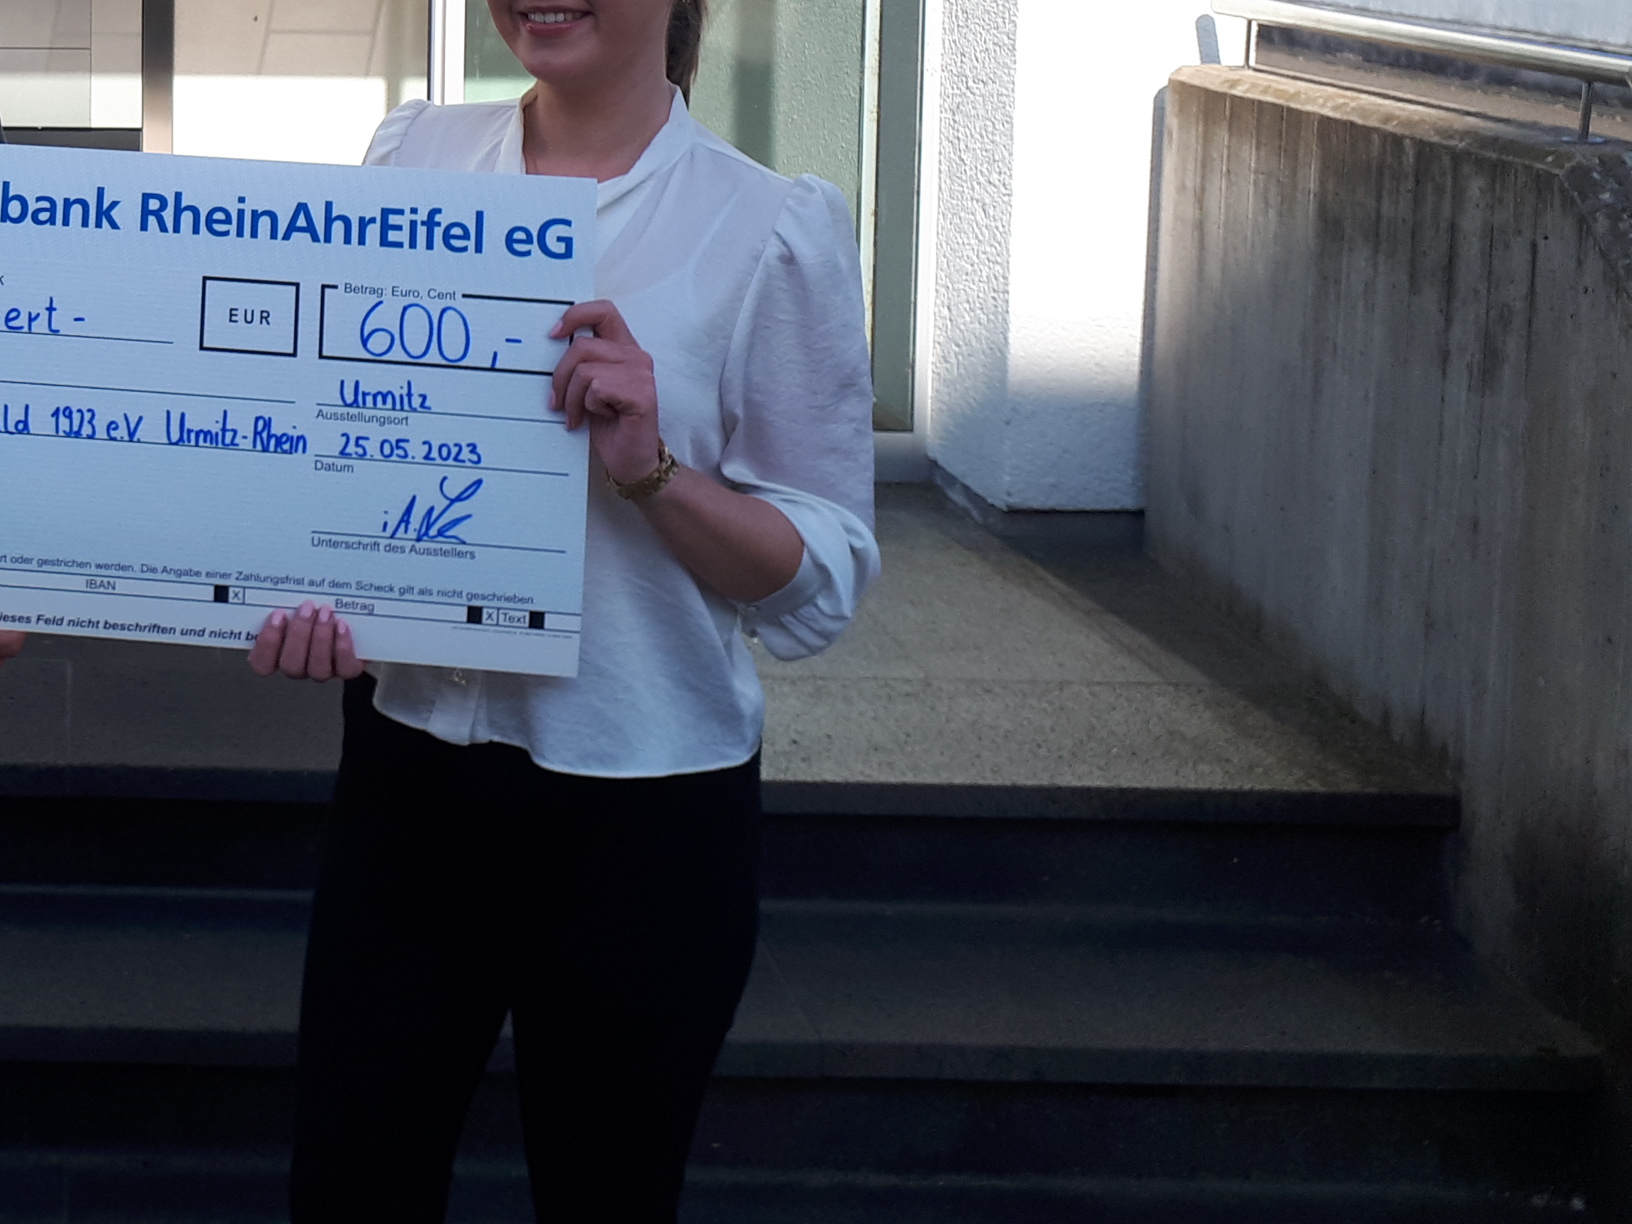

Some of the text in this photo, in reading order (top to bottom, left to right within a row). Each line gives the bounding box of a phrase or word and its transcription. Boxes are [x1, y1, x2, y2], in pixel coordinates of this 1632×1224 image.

[140, 192, 484, 254] RheinAhrEifel
[505, 218, 574, 260] eG
[344, 283, 457, 301] Betrag: Euro, Cent
[228, 307, 272, 326] EUR
[340, 379, 432, 411] Urmitz
[51, 405, 97, 440] 1923
[316, 408, 409, 427] Ausstellungsort
[338, 432, 482, 465] 25.05.2023
[313, 460, 354, 474] Datum
[311, 536, 476, 560] Unterschrift des Ausstellers
[10, 554, 34, 565] oder
[37, 556, 91, 571] gestrichen
[95, 559, 136, 573] werden.
[141, 563, 158, 574] Die
[161, 564, 202, 580] Angabe
[205, 569, 232, 580] einer
[235, 570, 306, 587] Zahlungsfrist
[308, 577, 325, 588] auf
[328, 578, 352, 590] dem
[354, 580, 396, 594] Scheck
[398, 583, 414, 596] gilt
[418, 584, 434, 596] als
[436, 586, 463, 599] nicht
[85, 579, 116, 591] IBAN
[231, 590, 241, 601] X
[335, 598, 375, 614] Betrag
[485, 611, 495, 622] X
[501, 611, 527, 625] Text
[36, 614, 65, 627] Feld
[68, 616, 101, 630] nicht
[103, 620, 177, 636] beschriften
[180, 626, 206, 638] und
[208, 628, 243, 642] nicht
